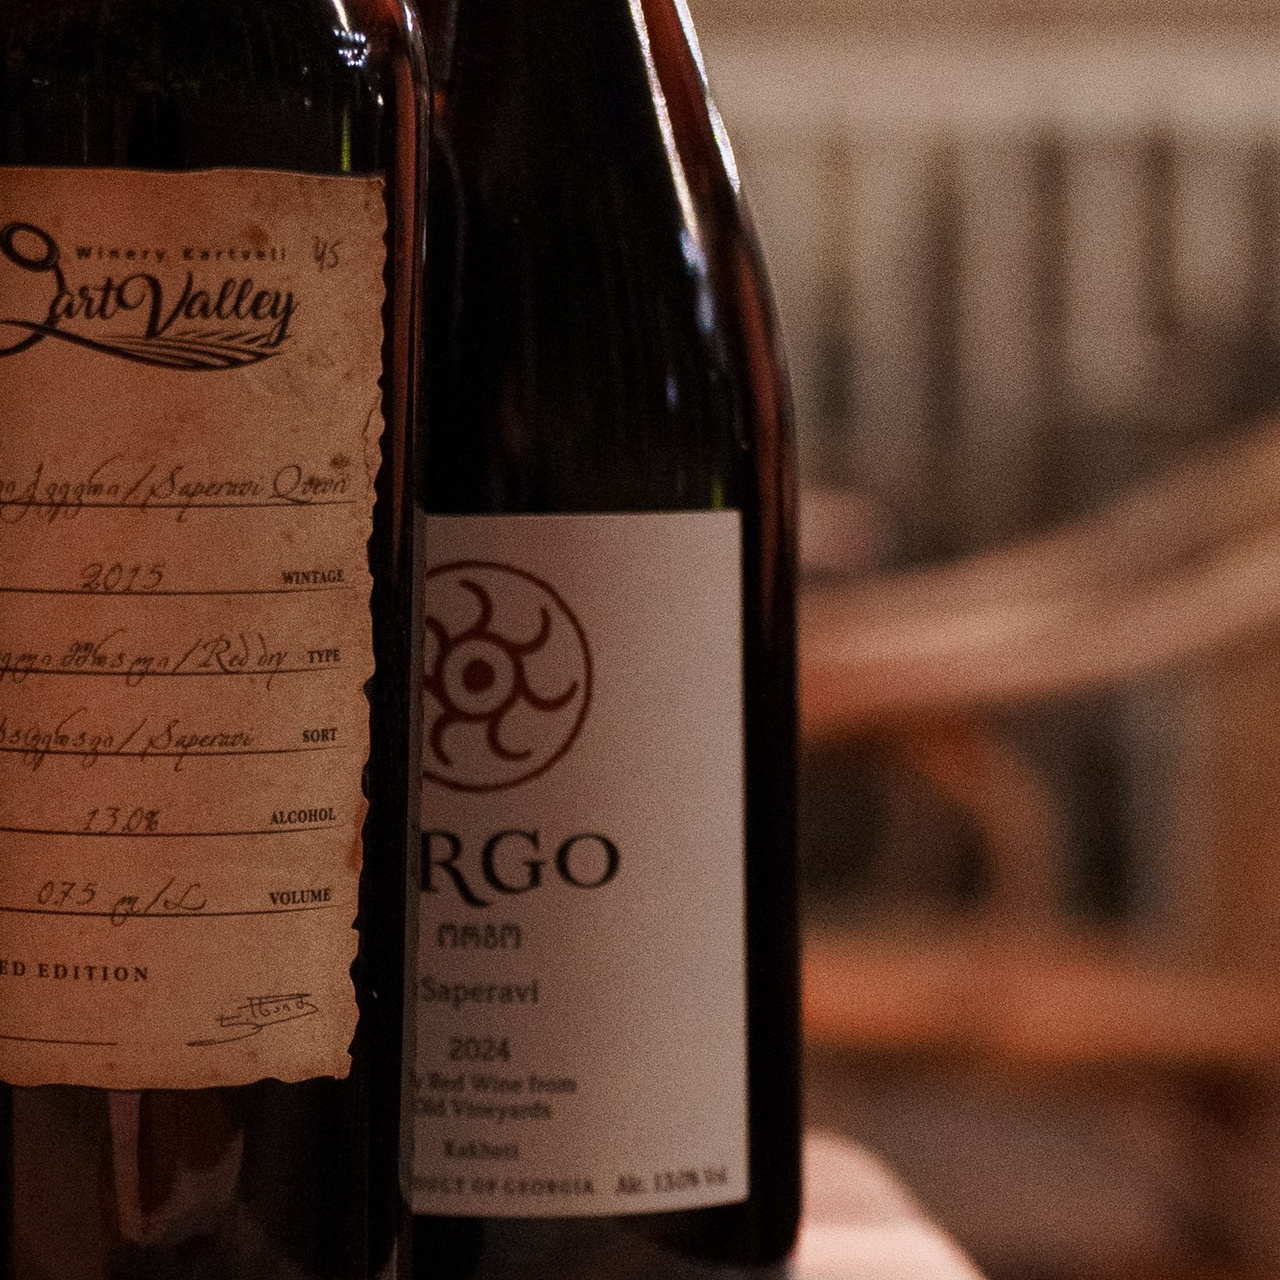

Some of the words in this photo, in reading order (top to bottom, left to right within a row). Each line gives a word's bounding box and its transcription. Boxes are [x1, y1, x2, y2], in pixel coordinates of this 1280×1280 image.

[75, 246, 166, 263] Winery
[78, 562, 166, 592] 2015
[282, 569, 346, 587] WINTAGE
[308, 648, 341, 666] TYPE
[302, 728, 339, 745] SORT
[269, 807, 337, 827] ALCOHOL
[268, 887, 331, 907] VOLUME
[37, 963, 150, 983] EDITION
[420, 977, 539, 1010] Saperavi
[449, 1037, 510, 1061] 2024
